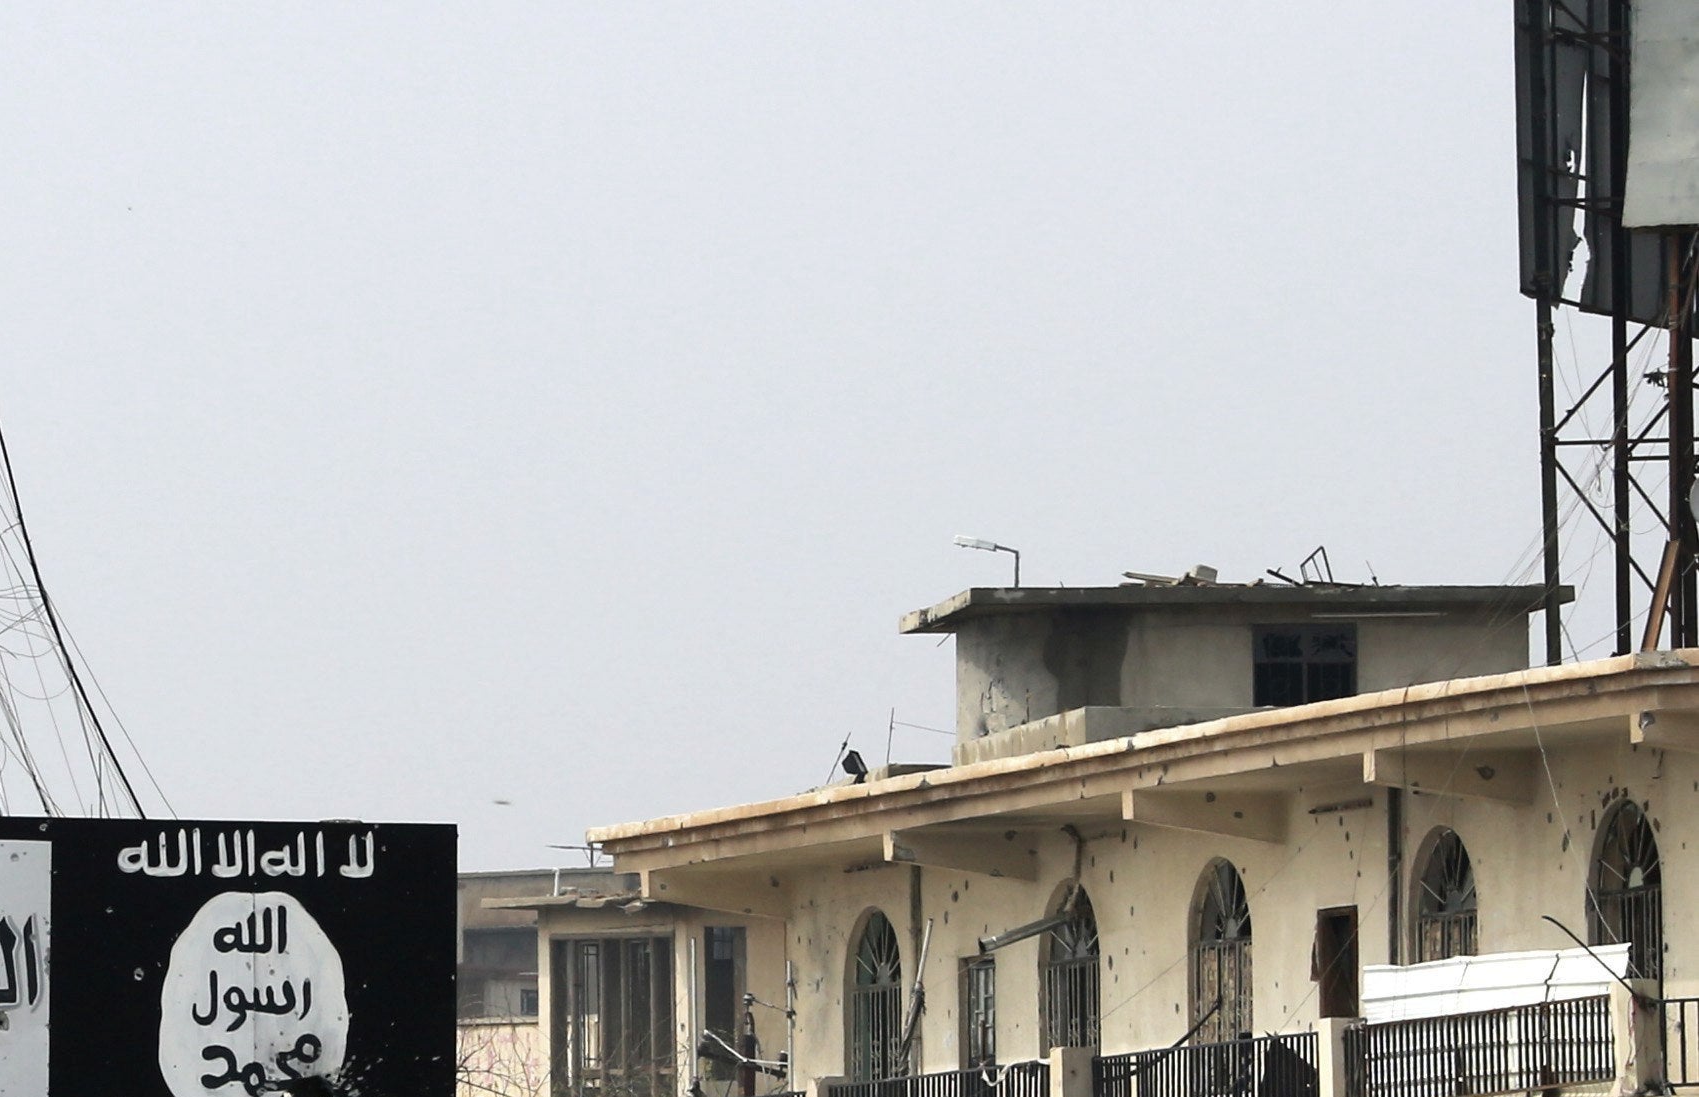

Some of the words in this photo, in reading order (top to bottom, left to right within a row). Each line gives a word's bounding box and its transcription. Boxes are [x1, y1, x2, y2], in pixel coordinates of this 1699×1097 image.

[117, 827, 201, 877] الله
[339, 831, 374, 879] لا
[213, 905, 287, 954] الله
[192, 970, 311, 1032] رسول
[201, 1033, 322, 1097] محمد
